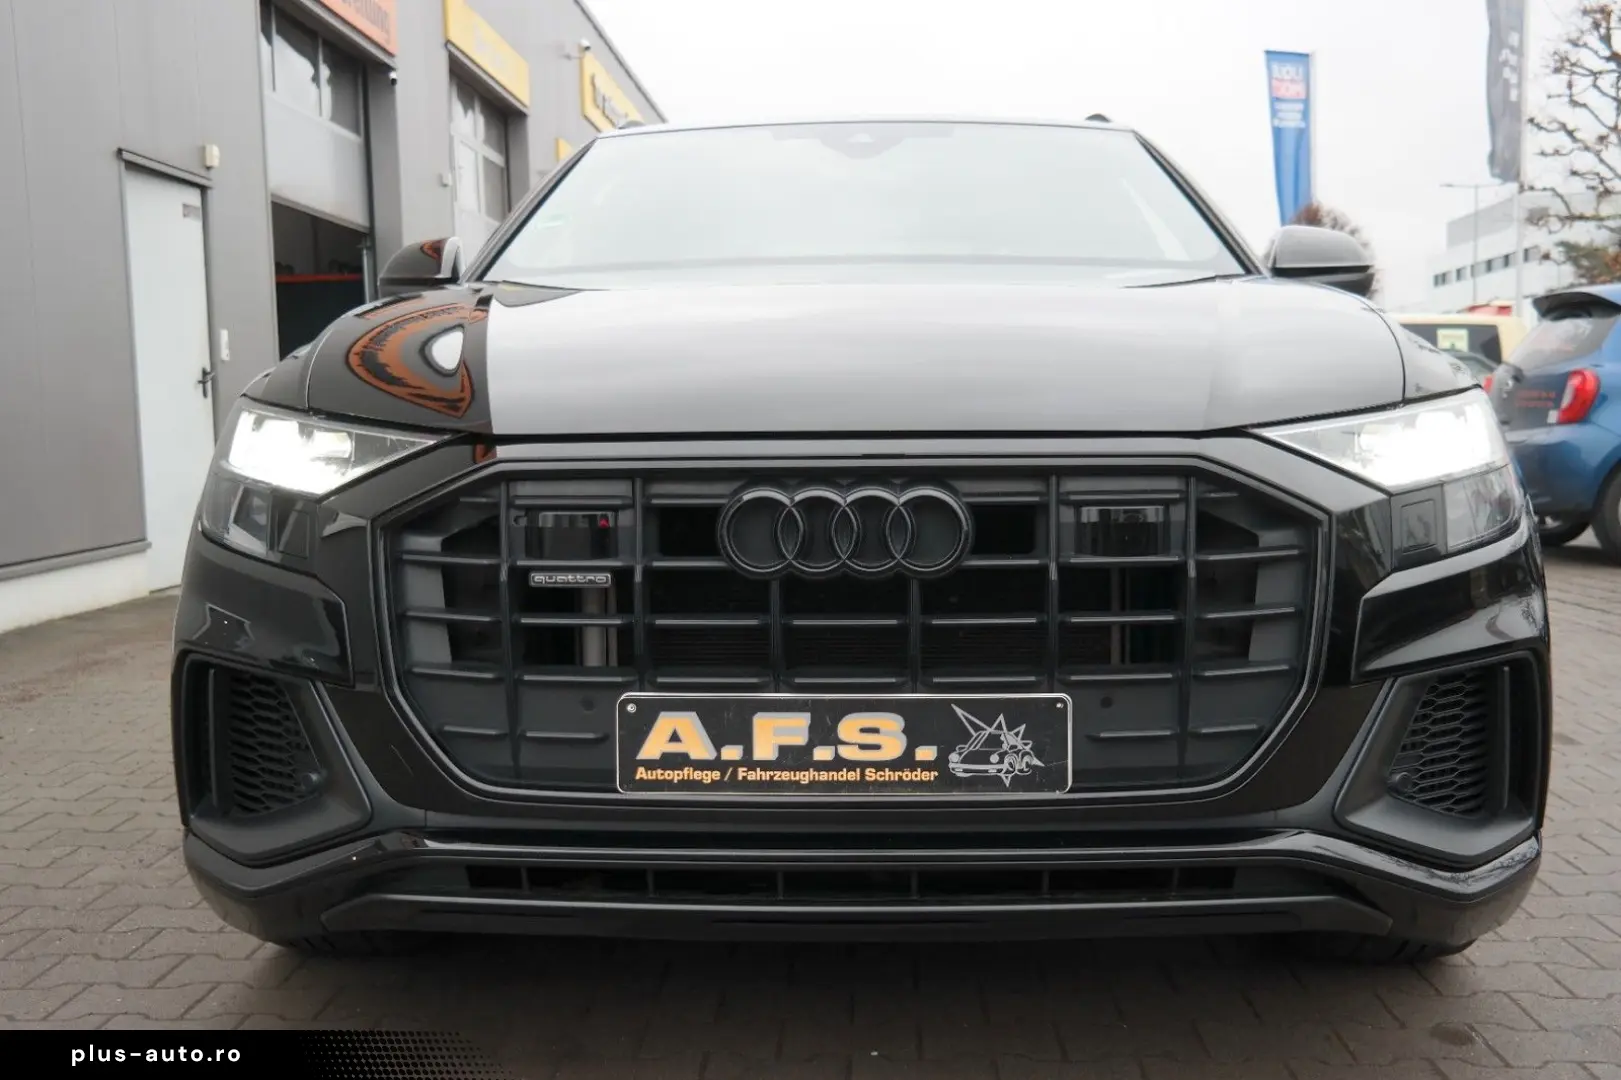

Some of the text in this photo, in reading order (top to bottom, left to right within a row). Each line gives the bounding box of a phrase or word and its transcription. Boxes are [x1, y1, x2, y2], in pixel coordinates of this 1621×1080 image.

[533, 574, 606, 584] quattro
[635, 711, 938, 760] A.F.S.
[634, 767, 939, 784] Autopflege / Fahrzeughandel Schröder
